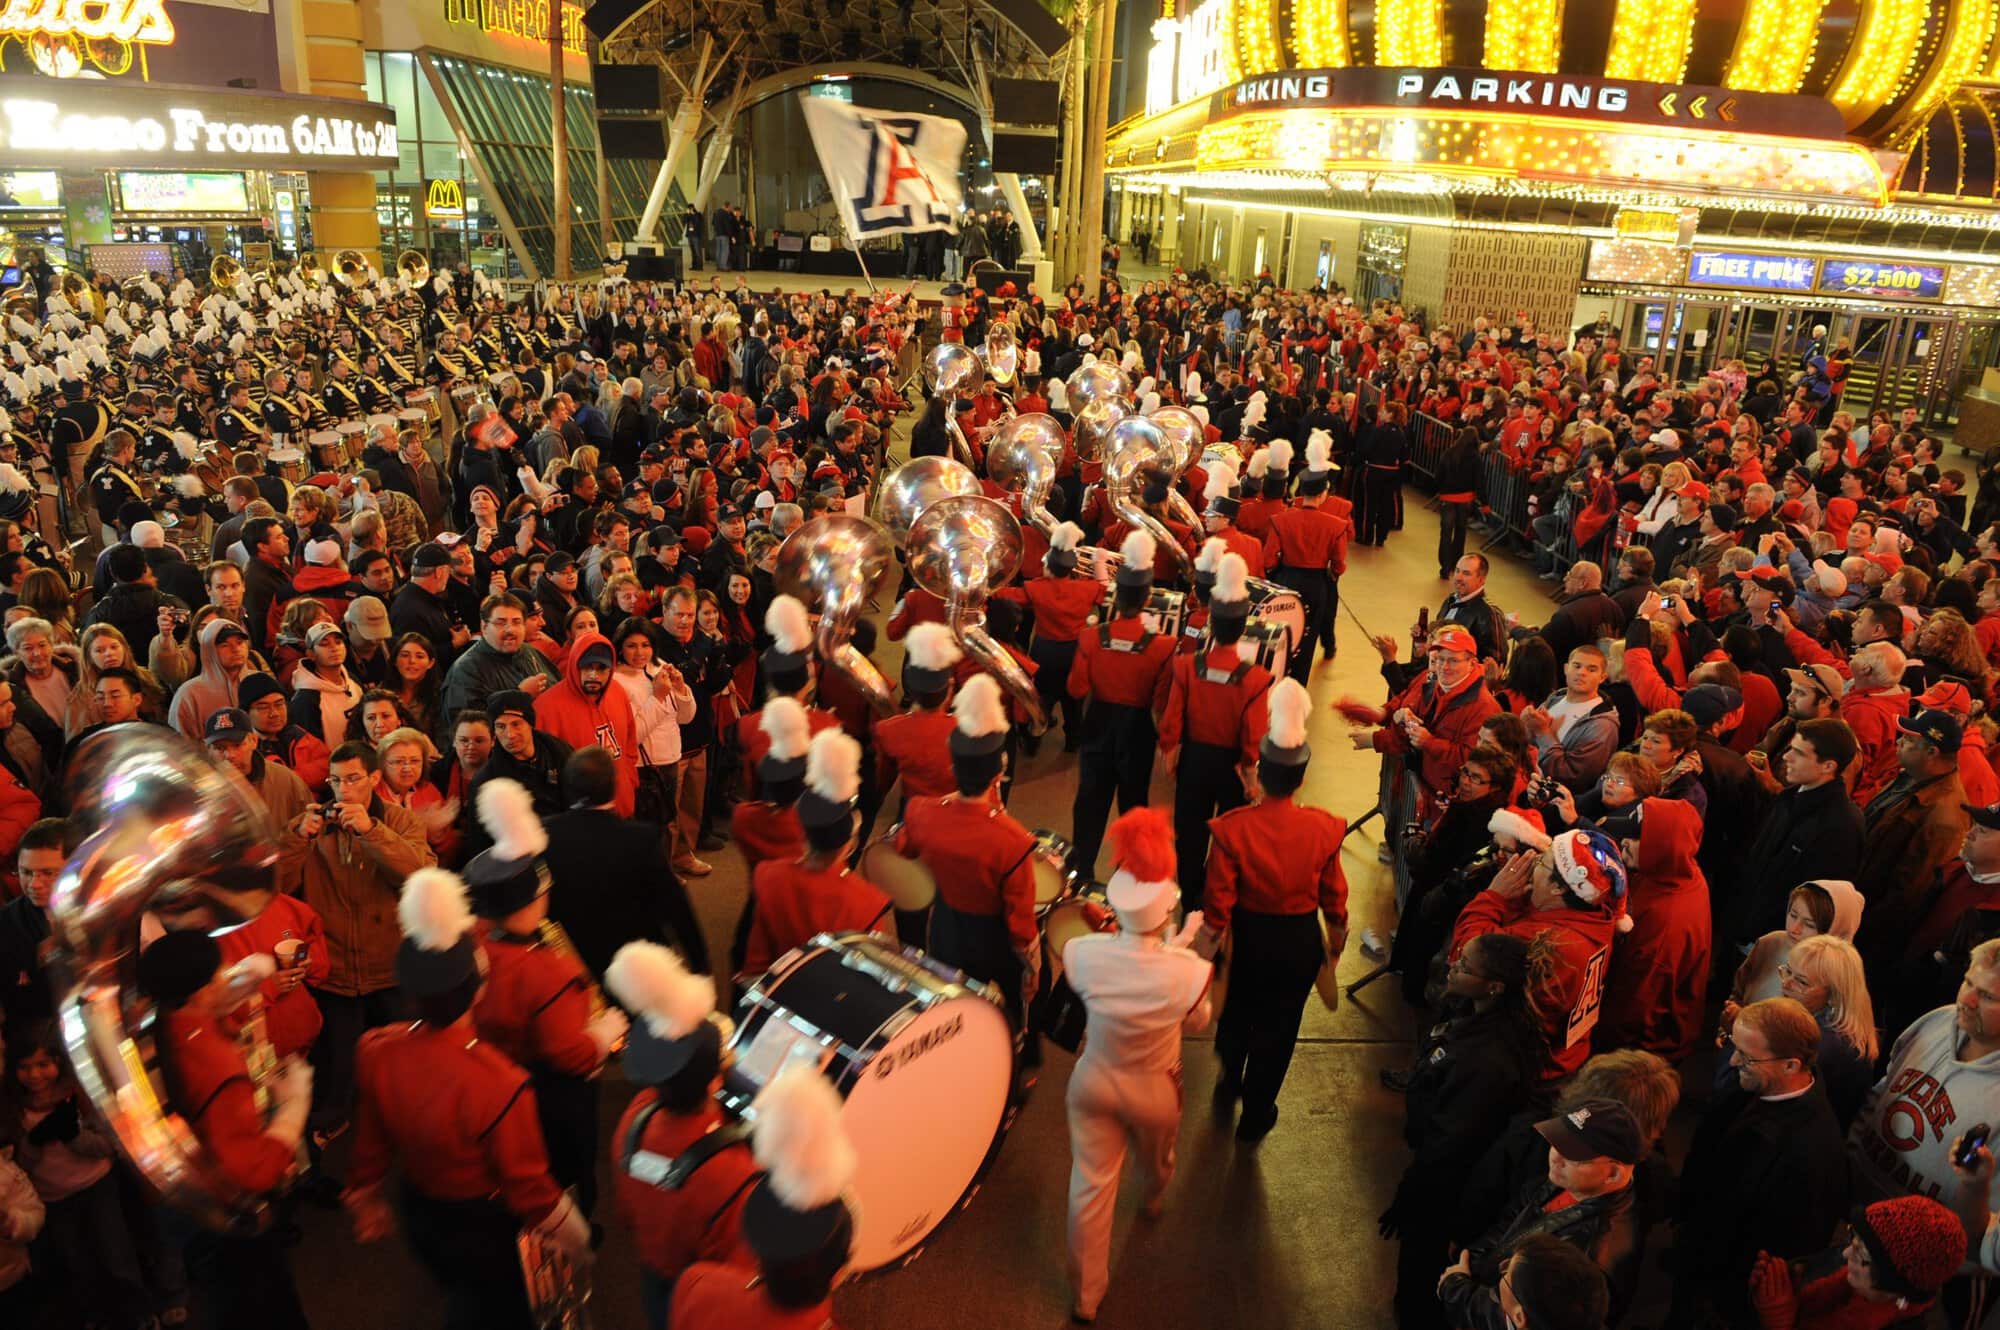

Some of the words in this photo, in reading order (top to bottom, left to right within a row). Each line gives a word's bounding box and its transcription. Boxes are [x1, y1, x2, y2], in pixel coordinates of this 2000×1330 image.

[1397, 75, 1628, 112] PARKING
[169, 108, 290, 154] From
[292, 114, 356, 155] 6AM
[356, 122, 376, 156] to
[1697, 256, 1750, 278] FREE
[1843, 266, 1922, 289] $2,500
[1568, 944, 1607, 1030] A
